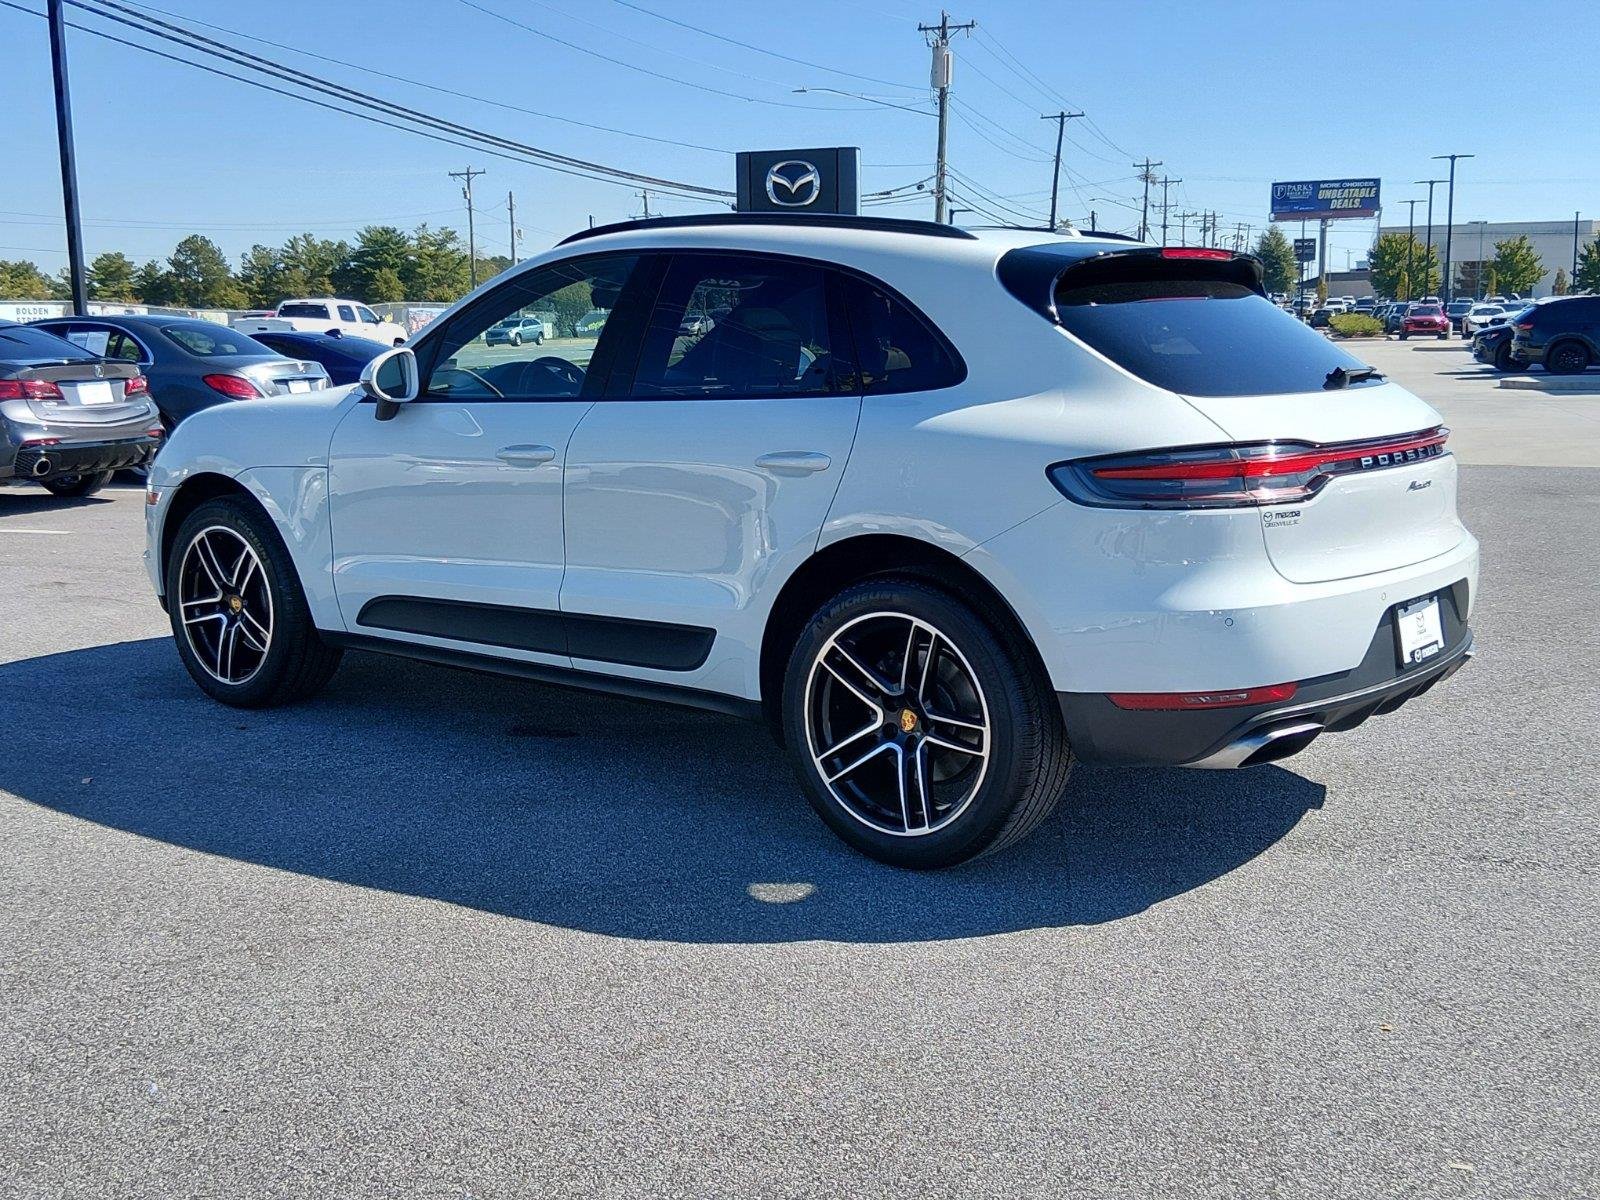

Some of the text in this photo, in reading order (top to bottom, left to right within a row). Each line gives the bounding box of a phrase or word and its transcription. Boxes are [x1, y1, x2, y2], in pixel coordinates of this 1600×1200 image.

[1317, 187, 1377, 199] UNBEATABLE
[1330, 198, 1362, 209] DEALS.
[16, 307, 49, 315] BOLDEN
[1361, 443, 1443, 469] PORSCHE
[829, 591, 893, 618] MICHELIN
